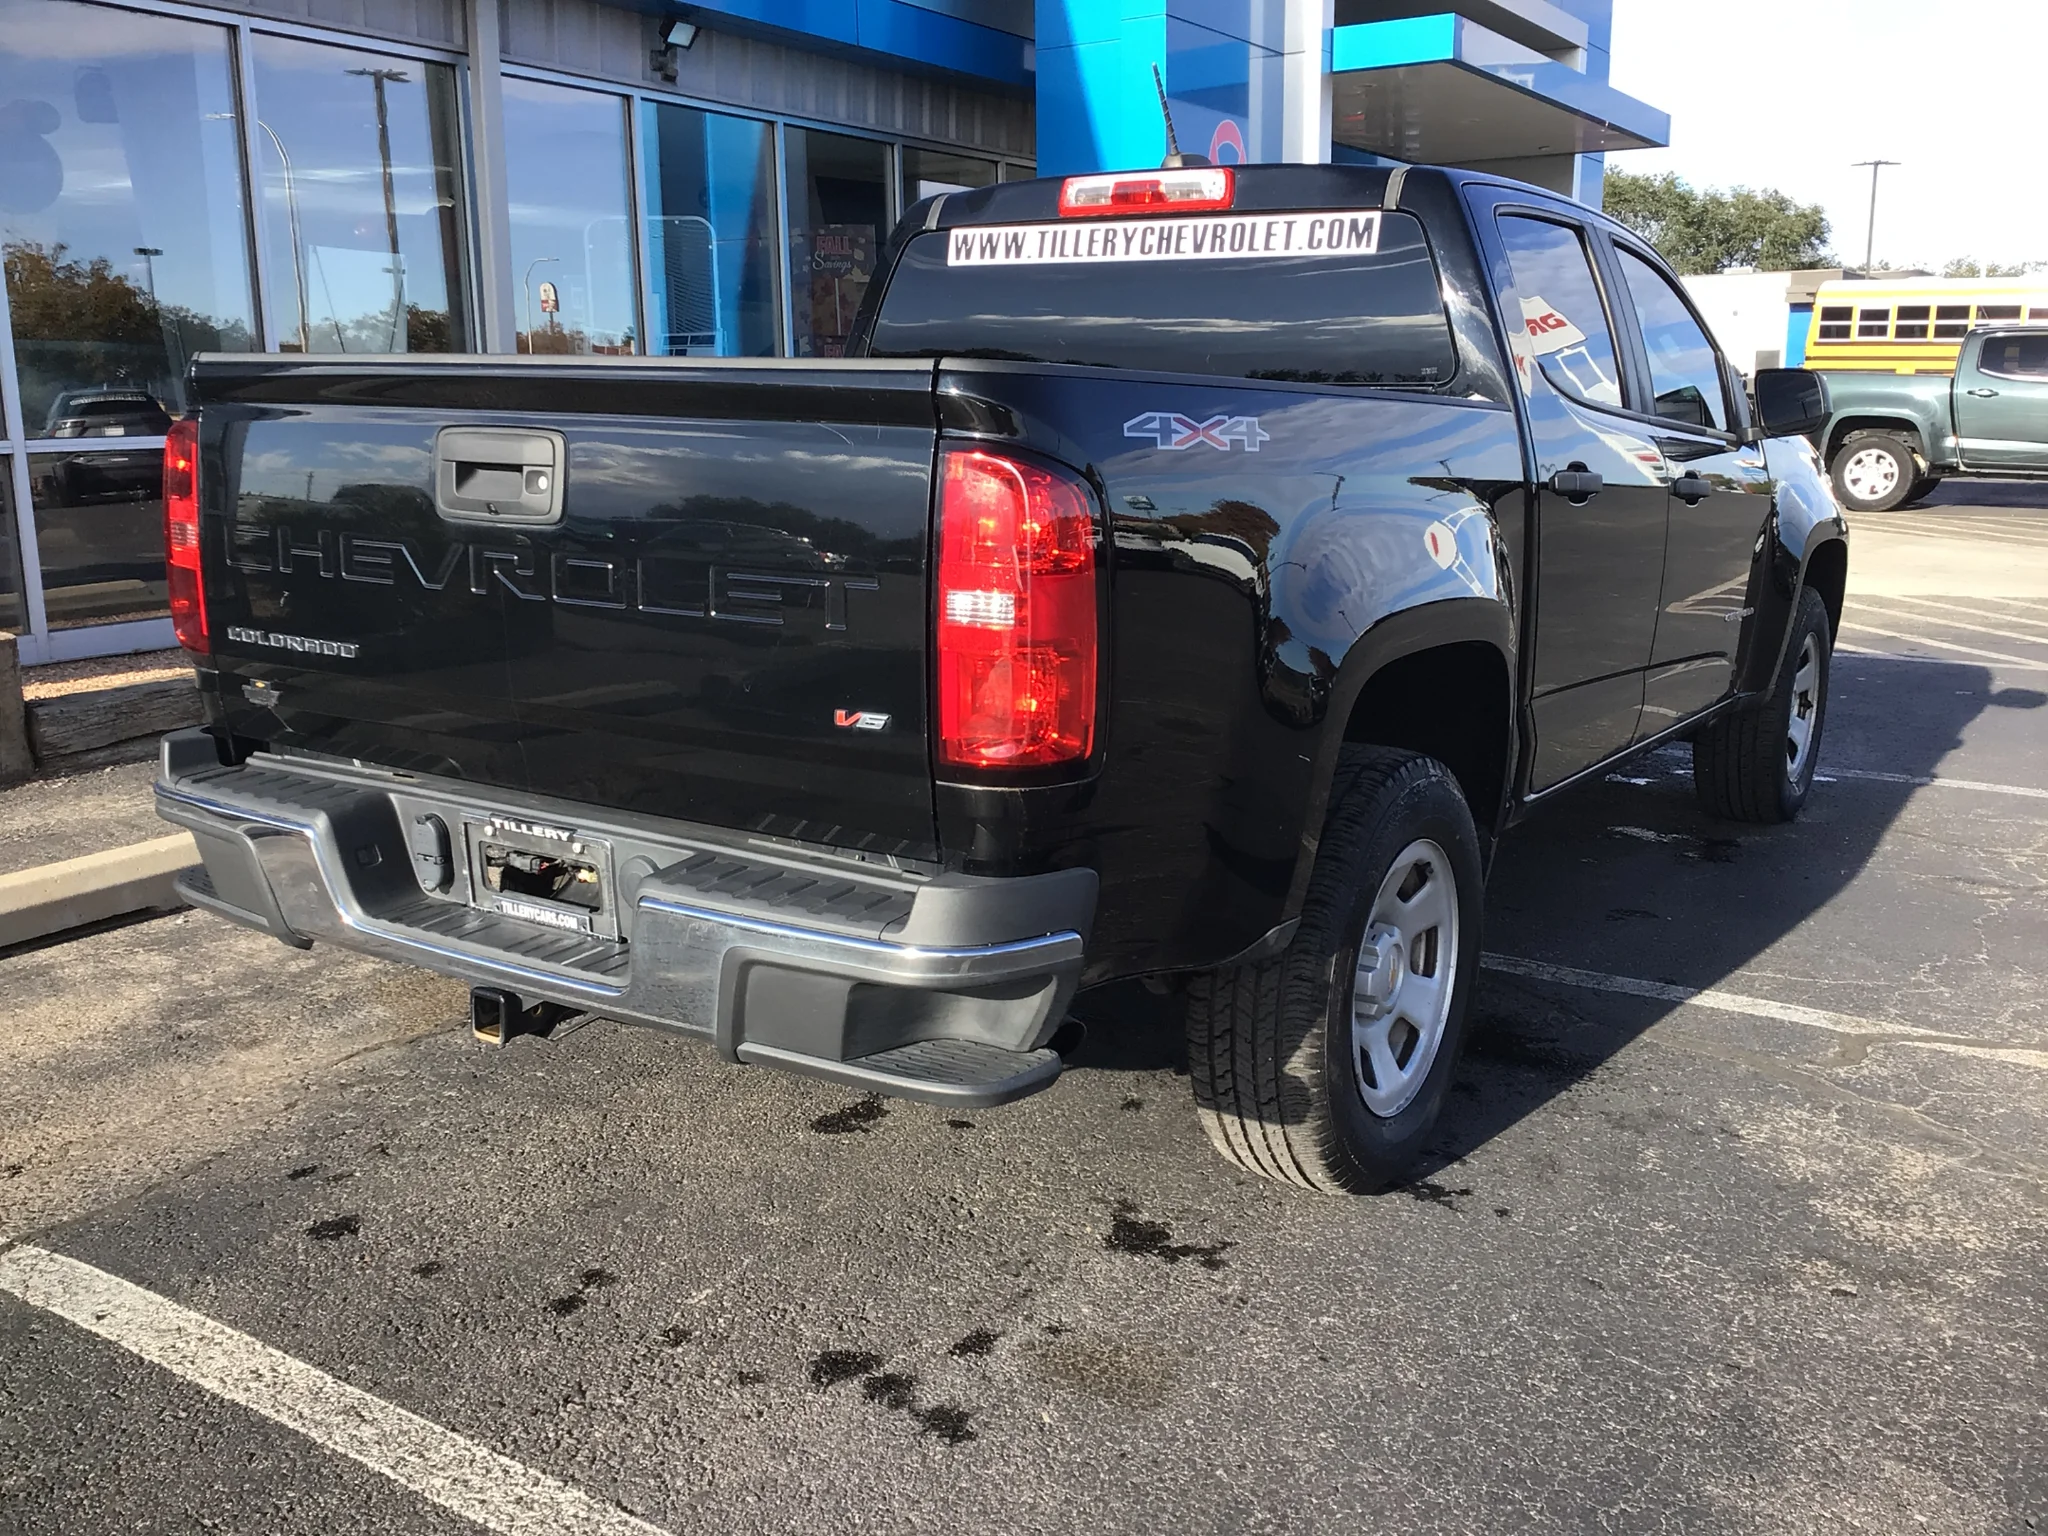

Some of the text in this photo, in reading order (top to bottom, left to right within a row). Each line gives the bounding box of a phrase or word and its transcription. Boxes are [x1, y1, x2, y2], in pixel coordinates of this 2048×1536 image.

[816, 236, 852, 254] FALL
[954, 217, 1375, 261] WWW.TILLERYCHEVROLET.COM
[812, 250, 852, 273] Savings
[1123, 411, 1270, 452] 4X4
[223, 523, 882, 631] CHEVROLET
[227, 626, 359, 658] COLORADO
[834, 709, 891, 730] V6
[491, 818, 570, 841] TILLERY
[501, 902, 578, 929] TILLERYCARS.COM
